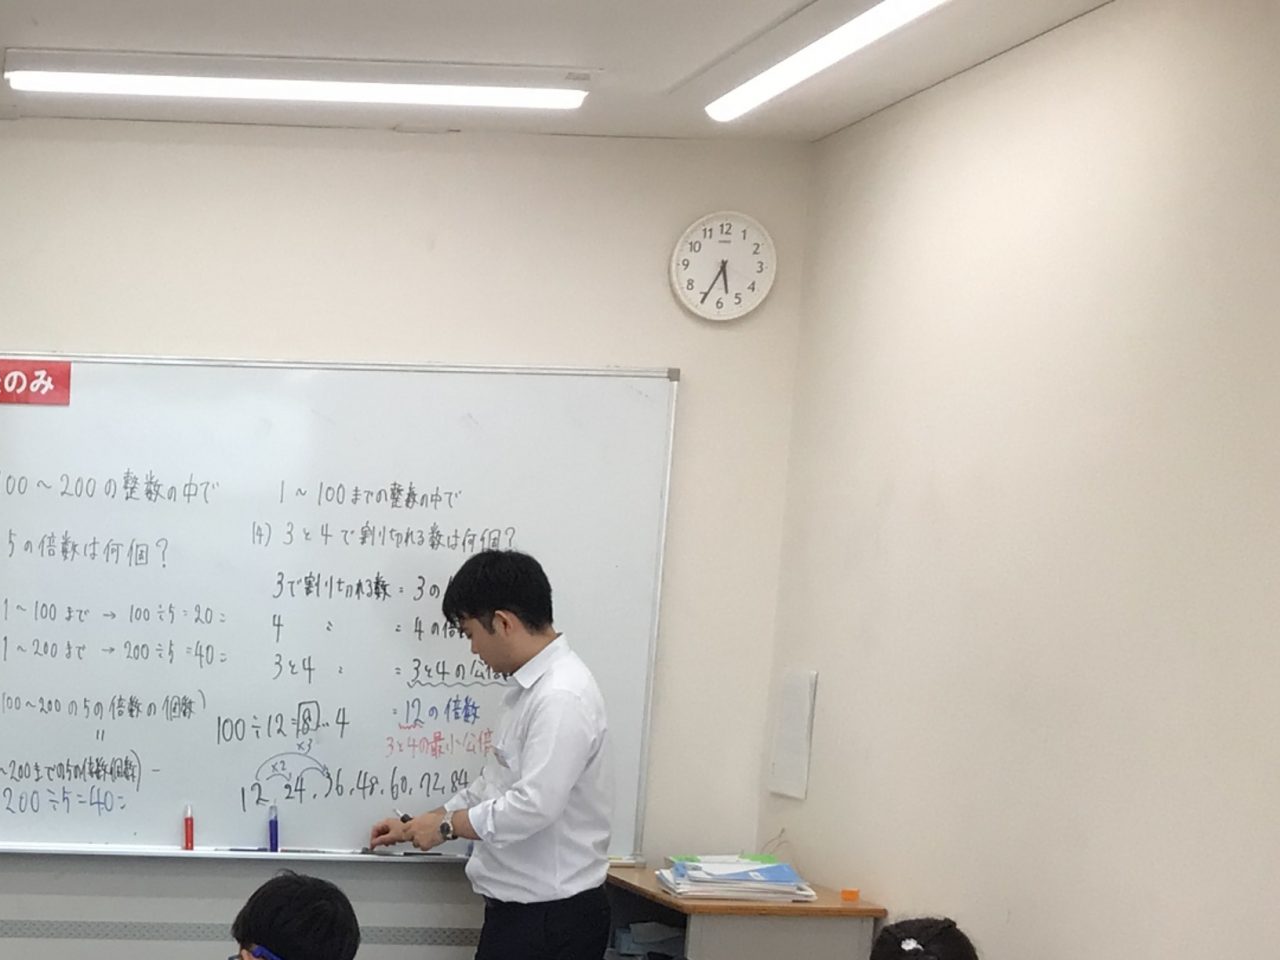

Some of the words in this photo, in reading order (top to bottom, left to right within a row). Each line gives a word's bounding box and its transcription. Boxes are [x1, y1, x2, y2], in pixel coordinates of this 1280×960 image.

[702, 227, 713, 239] 11
[720, 222, 732, 235] 12
[741, 228, 747, 240] 1
[688, 240, 702, 253] 10
[752, 242, 761, 255] 2
[681, 258, 690, 271] 9
[756, 260, 764, 273] 3
[686, 278, 695, 291] 8
[747, 280, 756, 292] 4
[715, 297, 724, 309] 6
[734, 292, 742, 305] 5
